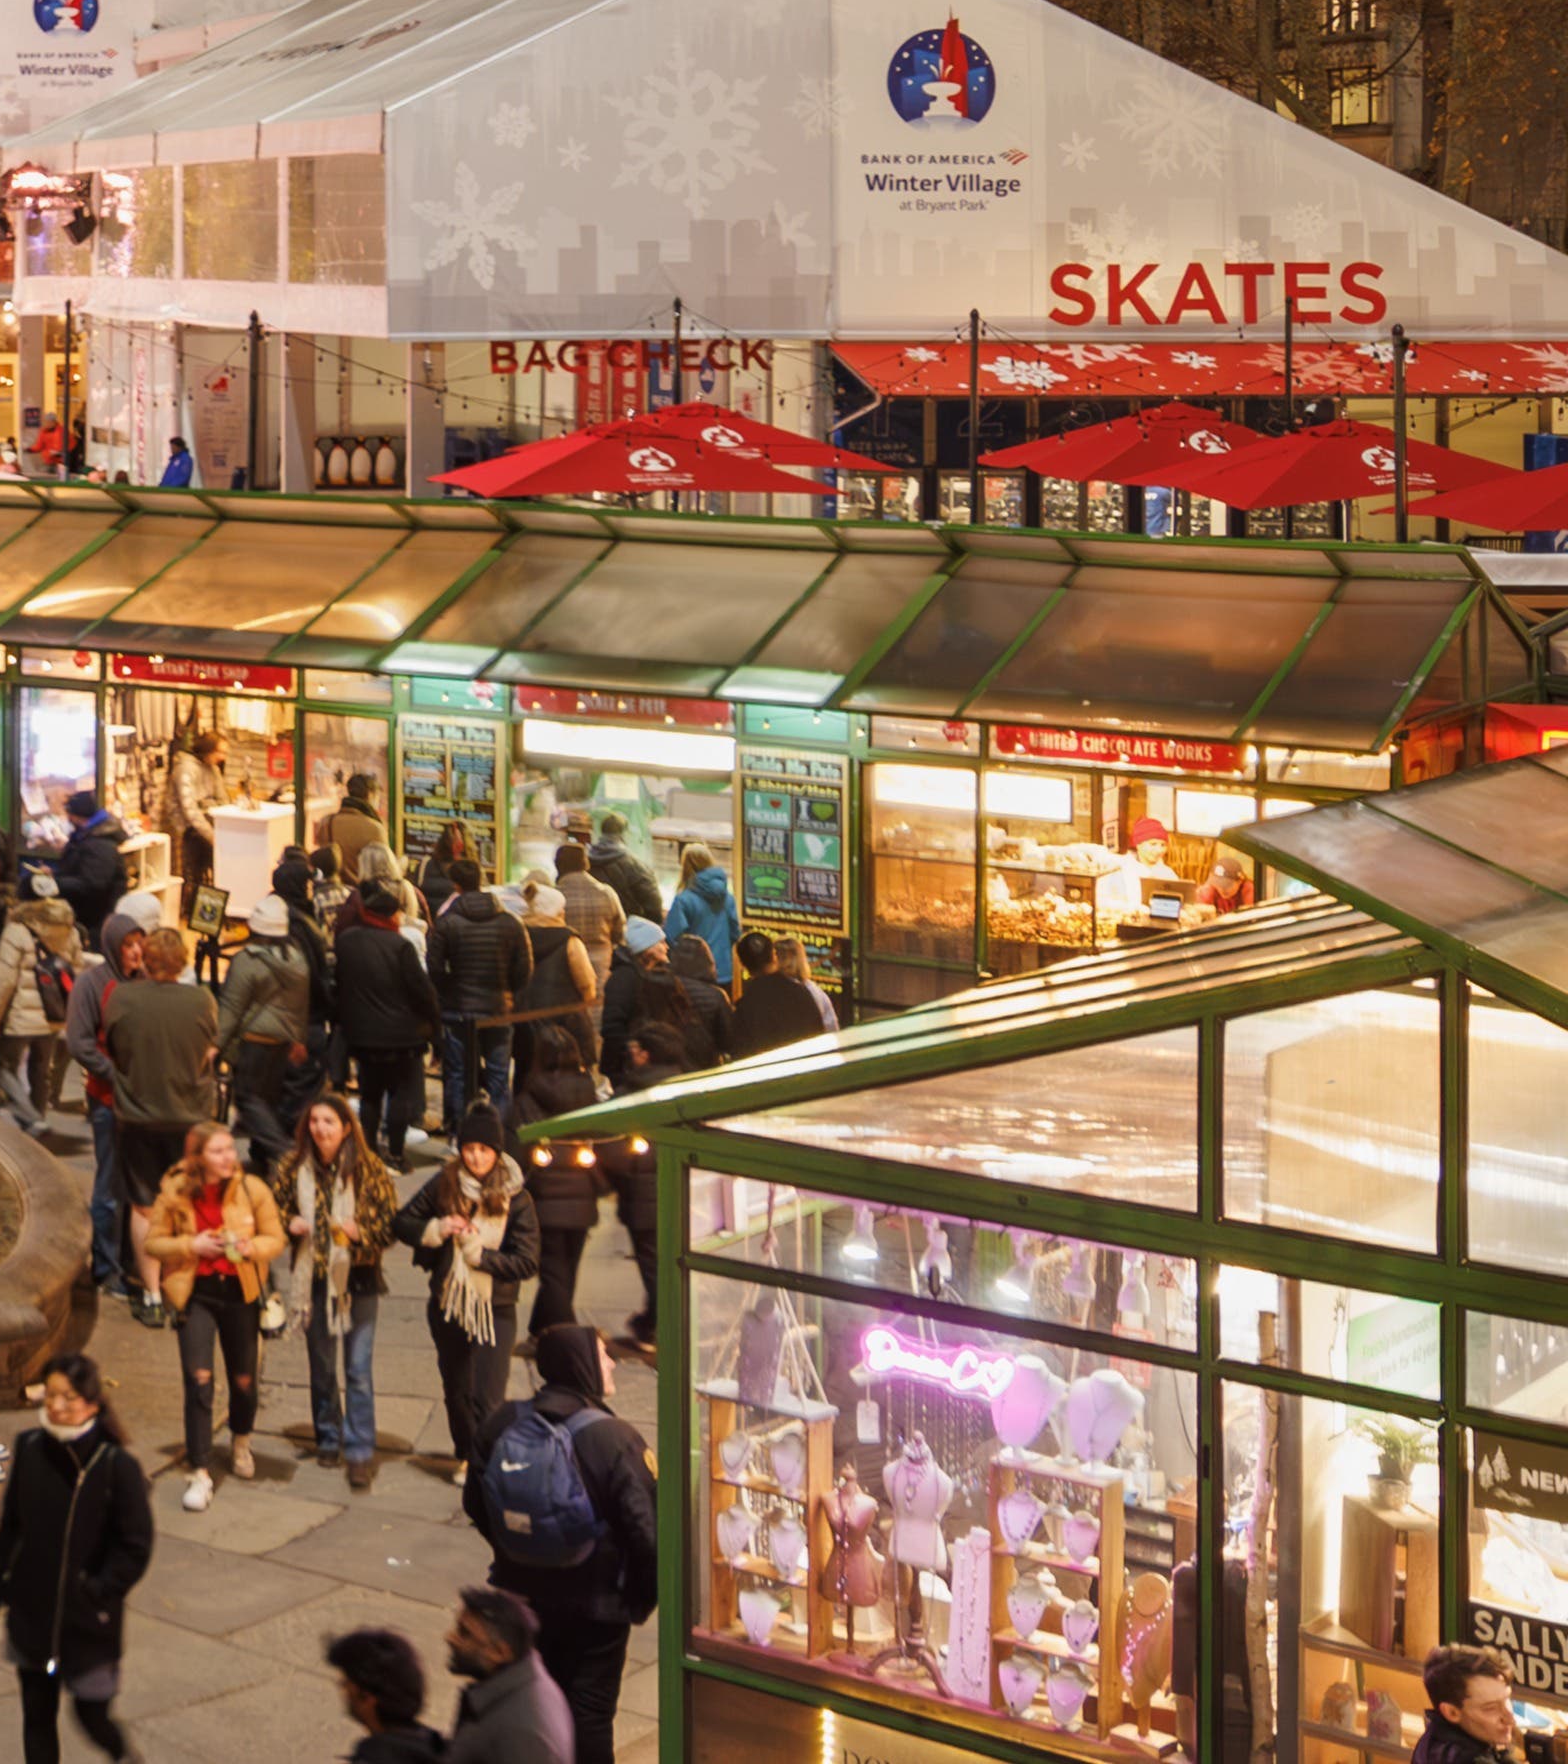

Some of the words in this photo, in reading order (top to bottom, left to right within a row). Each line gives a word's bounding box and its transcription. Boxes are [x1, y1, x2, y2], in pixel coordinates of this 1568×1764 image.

[19, 64, 66, 76] Winter
[68, 64, 114, 78] Village
[860, 154, 902, 165] BANK
[906, 154, 924, 165] OF
[928, 154, 996, 165] AMERICA
[865, 173, 943, 192] Winter
[945, 173, 1021, 198] Village
[899, 200, 912, 211] at
[915, 199, 957, 214] Bryant
[1048, 262, 1387, 326] SKATES
[489, 340, 588, 374] BAG
[607, 339, 772, 372] CHECK
[1029, 730, 1078, 751] UNITED
[1082, 735, 1158, 758] CHOCOLATE
[1163, 740, 1213, 762] WORKS
